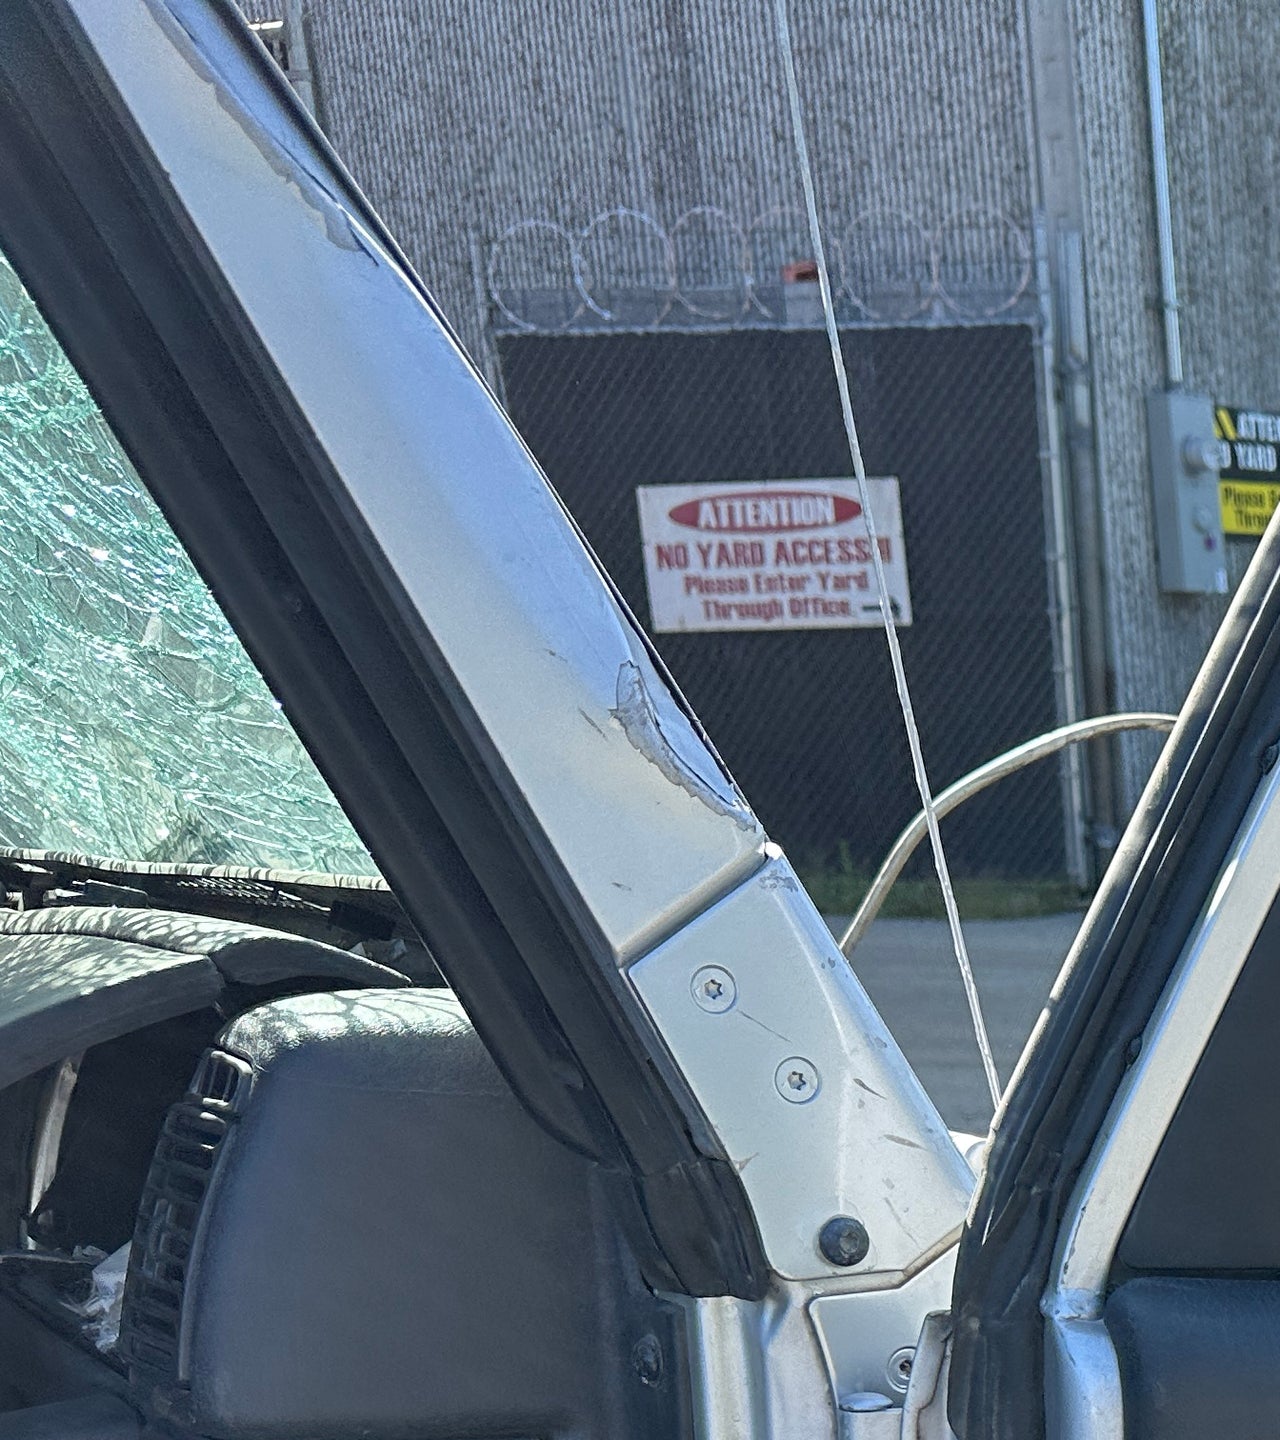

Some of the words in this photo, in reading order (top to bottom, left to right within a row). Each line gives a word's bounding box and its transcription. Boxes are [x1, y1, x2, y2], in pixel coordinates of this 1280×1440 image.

[700, 497, 835, 529] ATTENTION
[656, 543, 688, 570] NO
[697, 541, 764, 568] YARD
[685, 574, 748, 595] Please
[754, 573, 809, 593] Enter
[817, 571, 868, 591] Yard
[703, 598, 783, 621] Through
